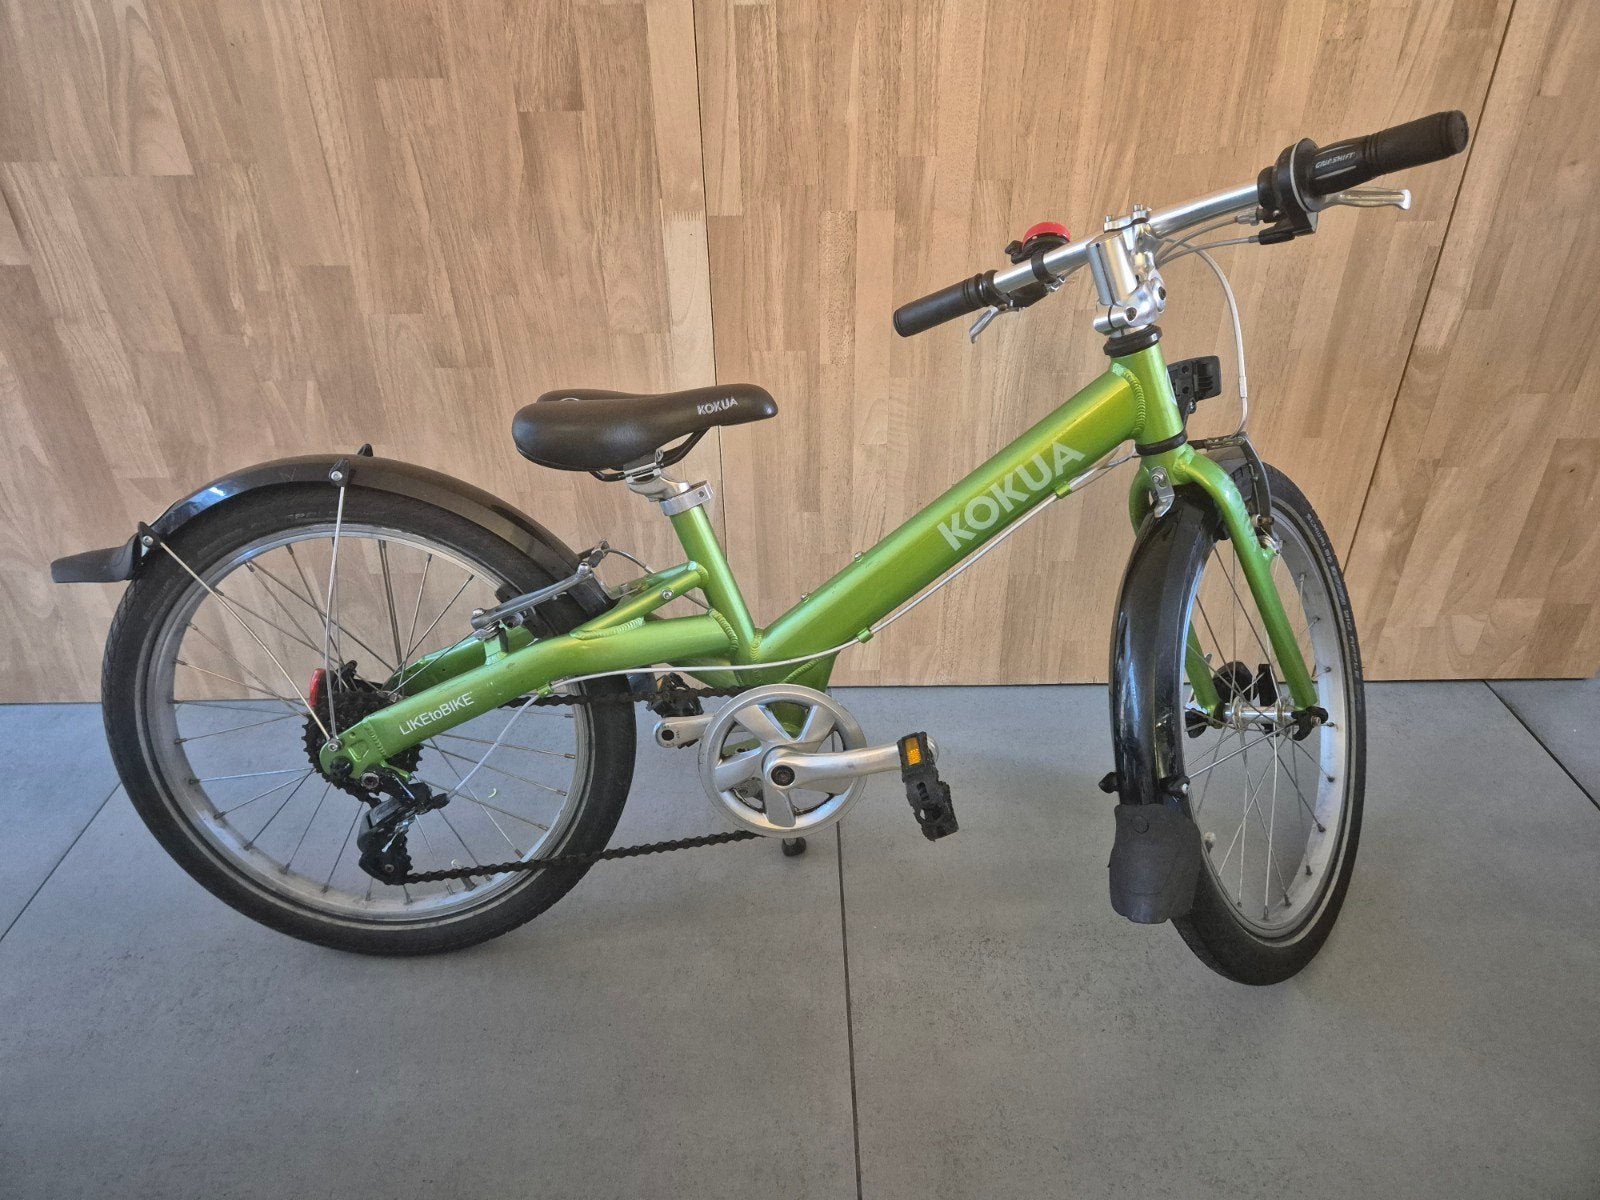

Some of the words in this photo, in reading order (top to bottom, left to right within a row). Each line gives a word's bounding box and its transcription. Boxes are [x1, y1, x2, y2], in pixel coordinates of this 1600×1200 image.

[695, 396, 740, 416] KOKUA
[936, 441, 1086, 552] KOKUA
[399, 691, 475, 735] LIKEtoBIKE
